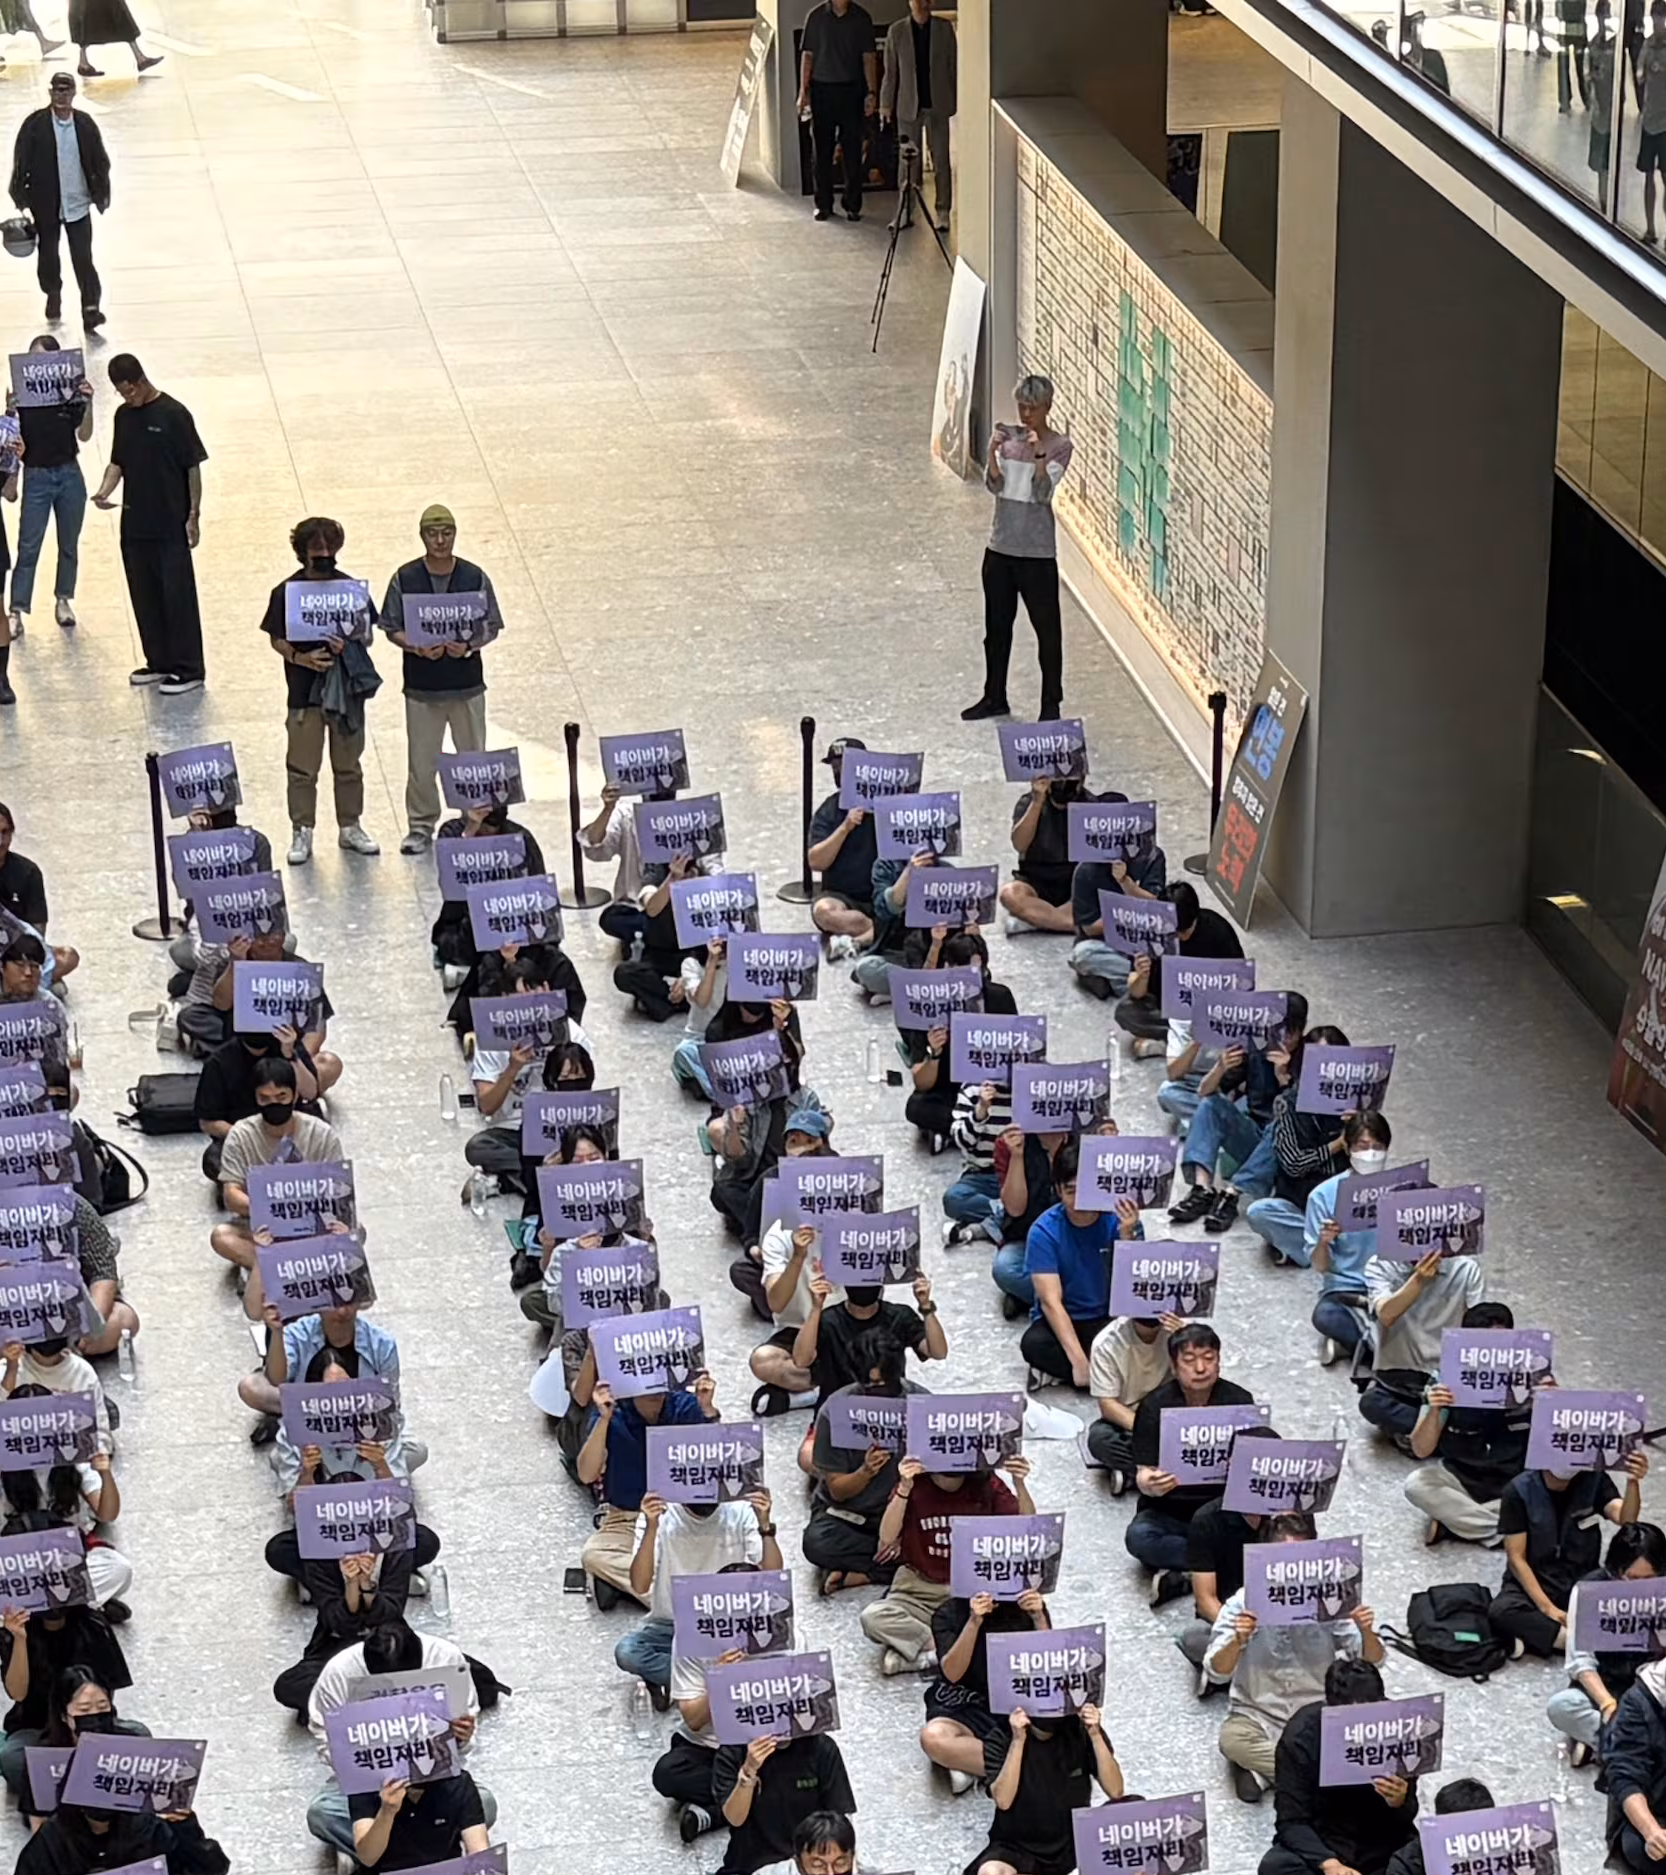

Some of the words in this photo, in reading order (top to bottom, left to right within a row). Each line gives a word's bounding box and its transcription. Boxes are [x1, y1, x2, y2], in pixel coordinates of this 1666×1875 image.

[613, 1326, 686, 1352] 네이버가
[302, 1394, 374, 1416] 네이버가
[1, 1411, 76, 1433] 네이버가
[928, 1411, 1001, 1431] 네이버가
[1552, 1410, 1624, 1430] 네이버가
[668, 1442, 742, 1463] 네이버가
[1252, 1457, 1323, 1477] 네이버가
[316, 1497, 392, 1519] 네이버가
[973, 1534, 1046, 1555] 네이버가
[1266, 1558, 1343, 1582] 네이버가
[694, 1592, 771, 1612] 네이버가
[1010, 1649, 1087, 1673] 네이버가
[730, 1674, 811, 1701] 네이버가
[347, 1714, 428, 1744] 네이버가
[1344, 1718, 1421, 1742] 네이버가
[98, 1753, 180, 1776] 네이버가
[1445, 1824, 1532, 1858] 네이버가
